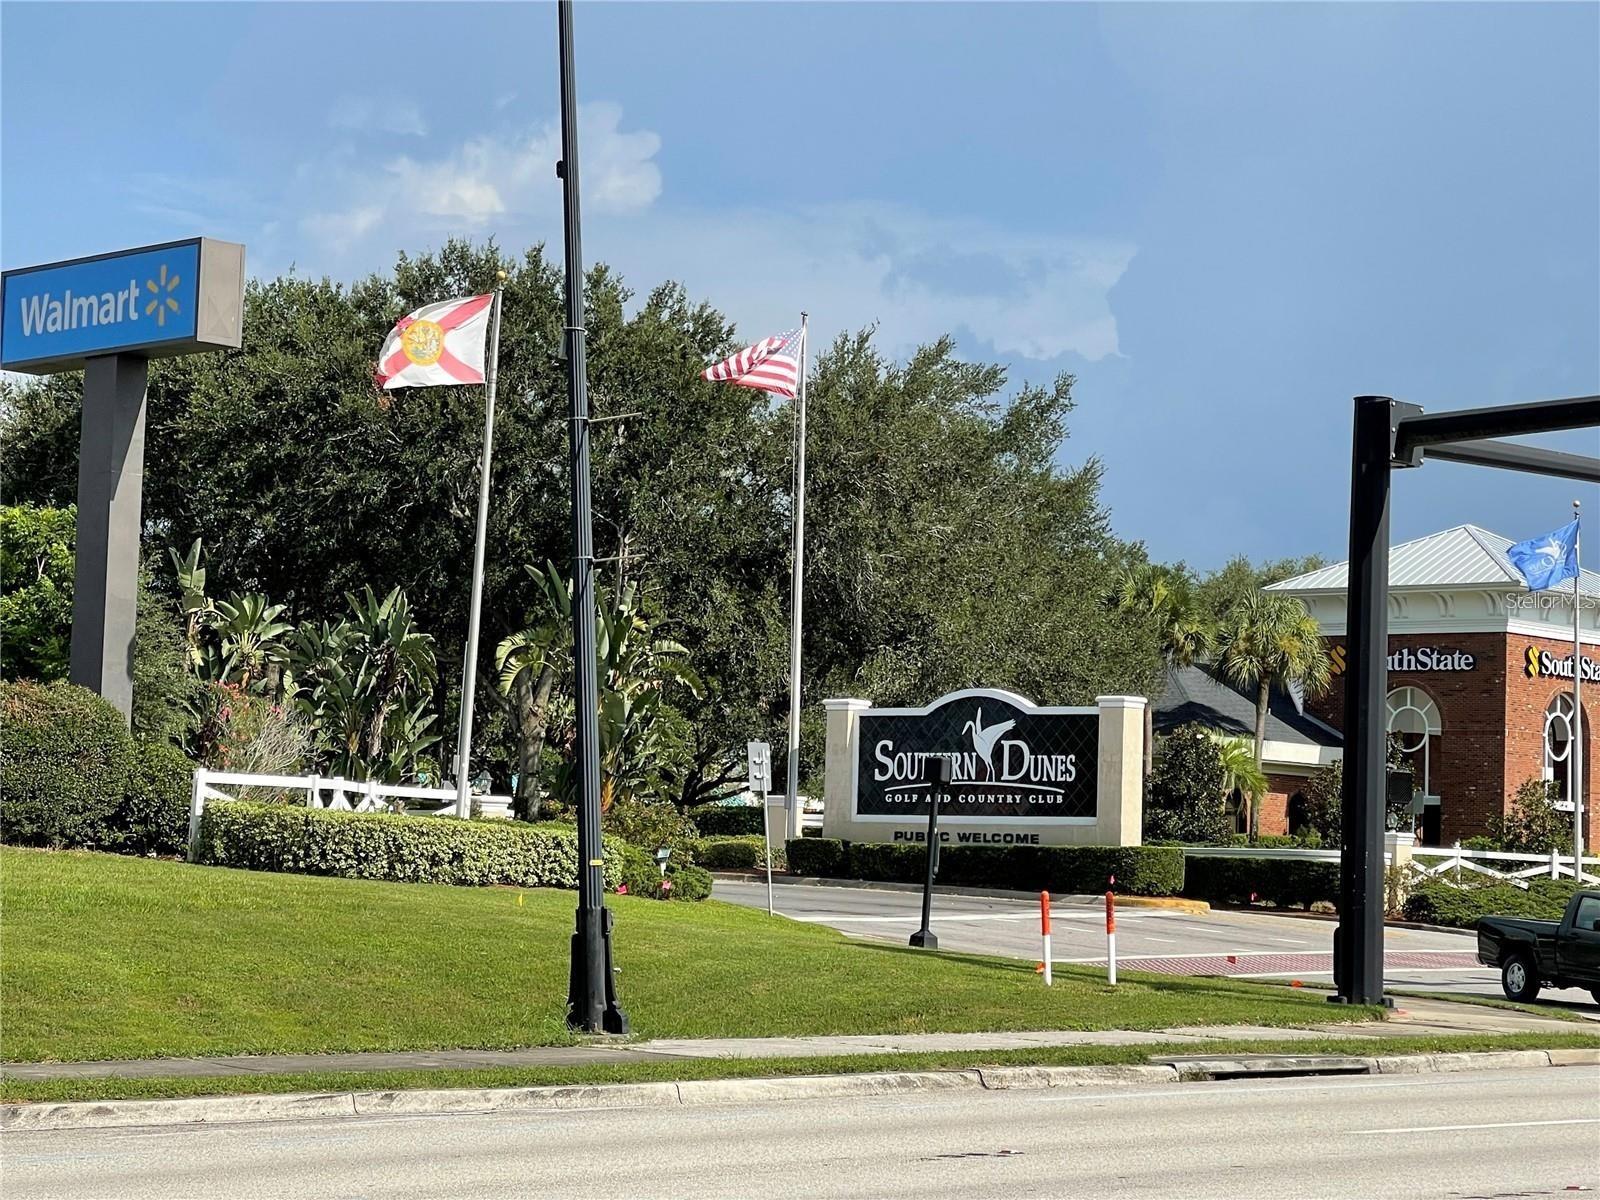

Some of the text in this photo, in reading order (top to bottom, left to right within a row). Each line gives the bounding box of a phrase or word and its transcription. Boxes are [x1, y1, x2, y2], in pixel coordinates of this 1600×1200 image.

[21, 279, 139, 337] Walmart
[1541, 651, 1600, 681] SoutSta
[874, 739, 1076, 782] SOUTRN DUNES
[885, 794, 918, 803] GOLF
[958, 794, 1022, 804] COUNTRY
[1028, 794, 1063, 804] CLUB
[893, 831, 1040, 844] PUBC WELCOME
